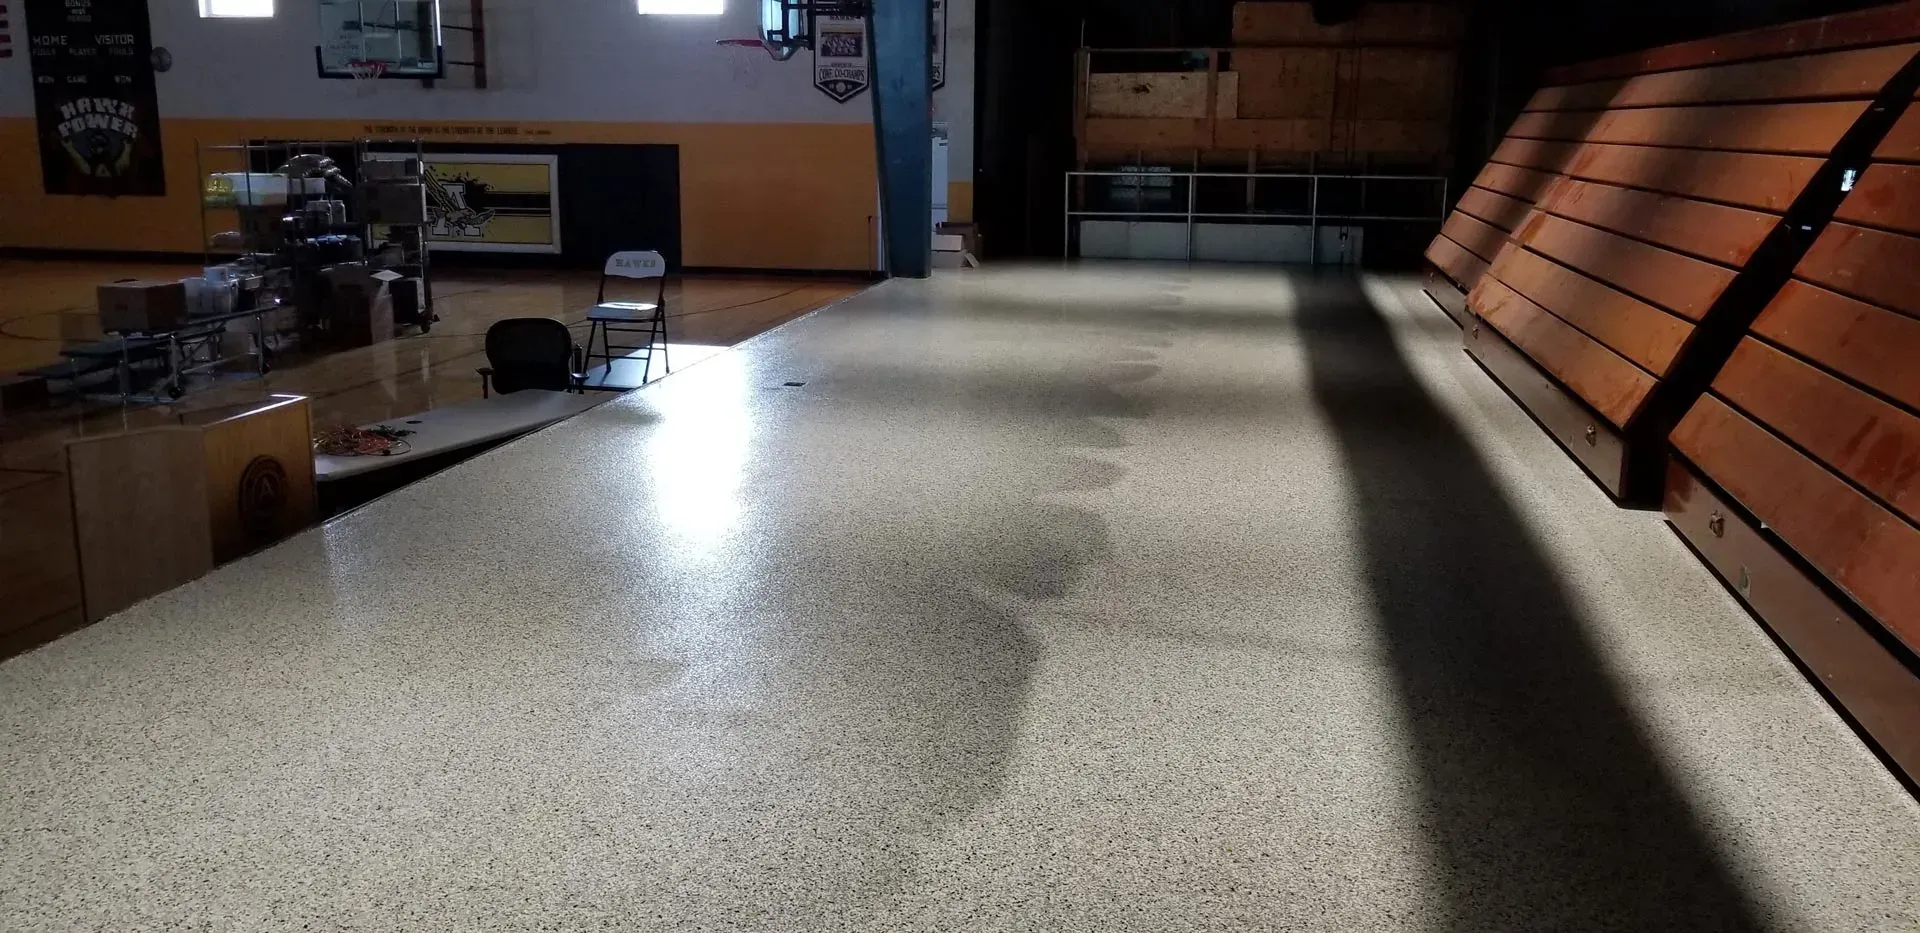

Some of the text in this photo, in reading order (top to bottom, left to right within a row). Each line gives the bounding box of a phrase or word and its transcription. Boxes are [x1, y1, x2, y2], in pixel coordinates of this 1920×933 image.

[32, 35, 68, 45] HOME
[94, 34, 135, 45] VISITOR
[60, 97, 136, 120] HAWK
[57, 114, 138, 138] POWER
